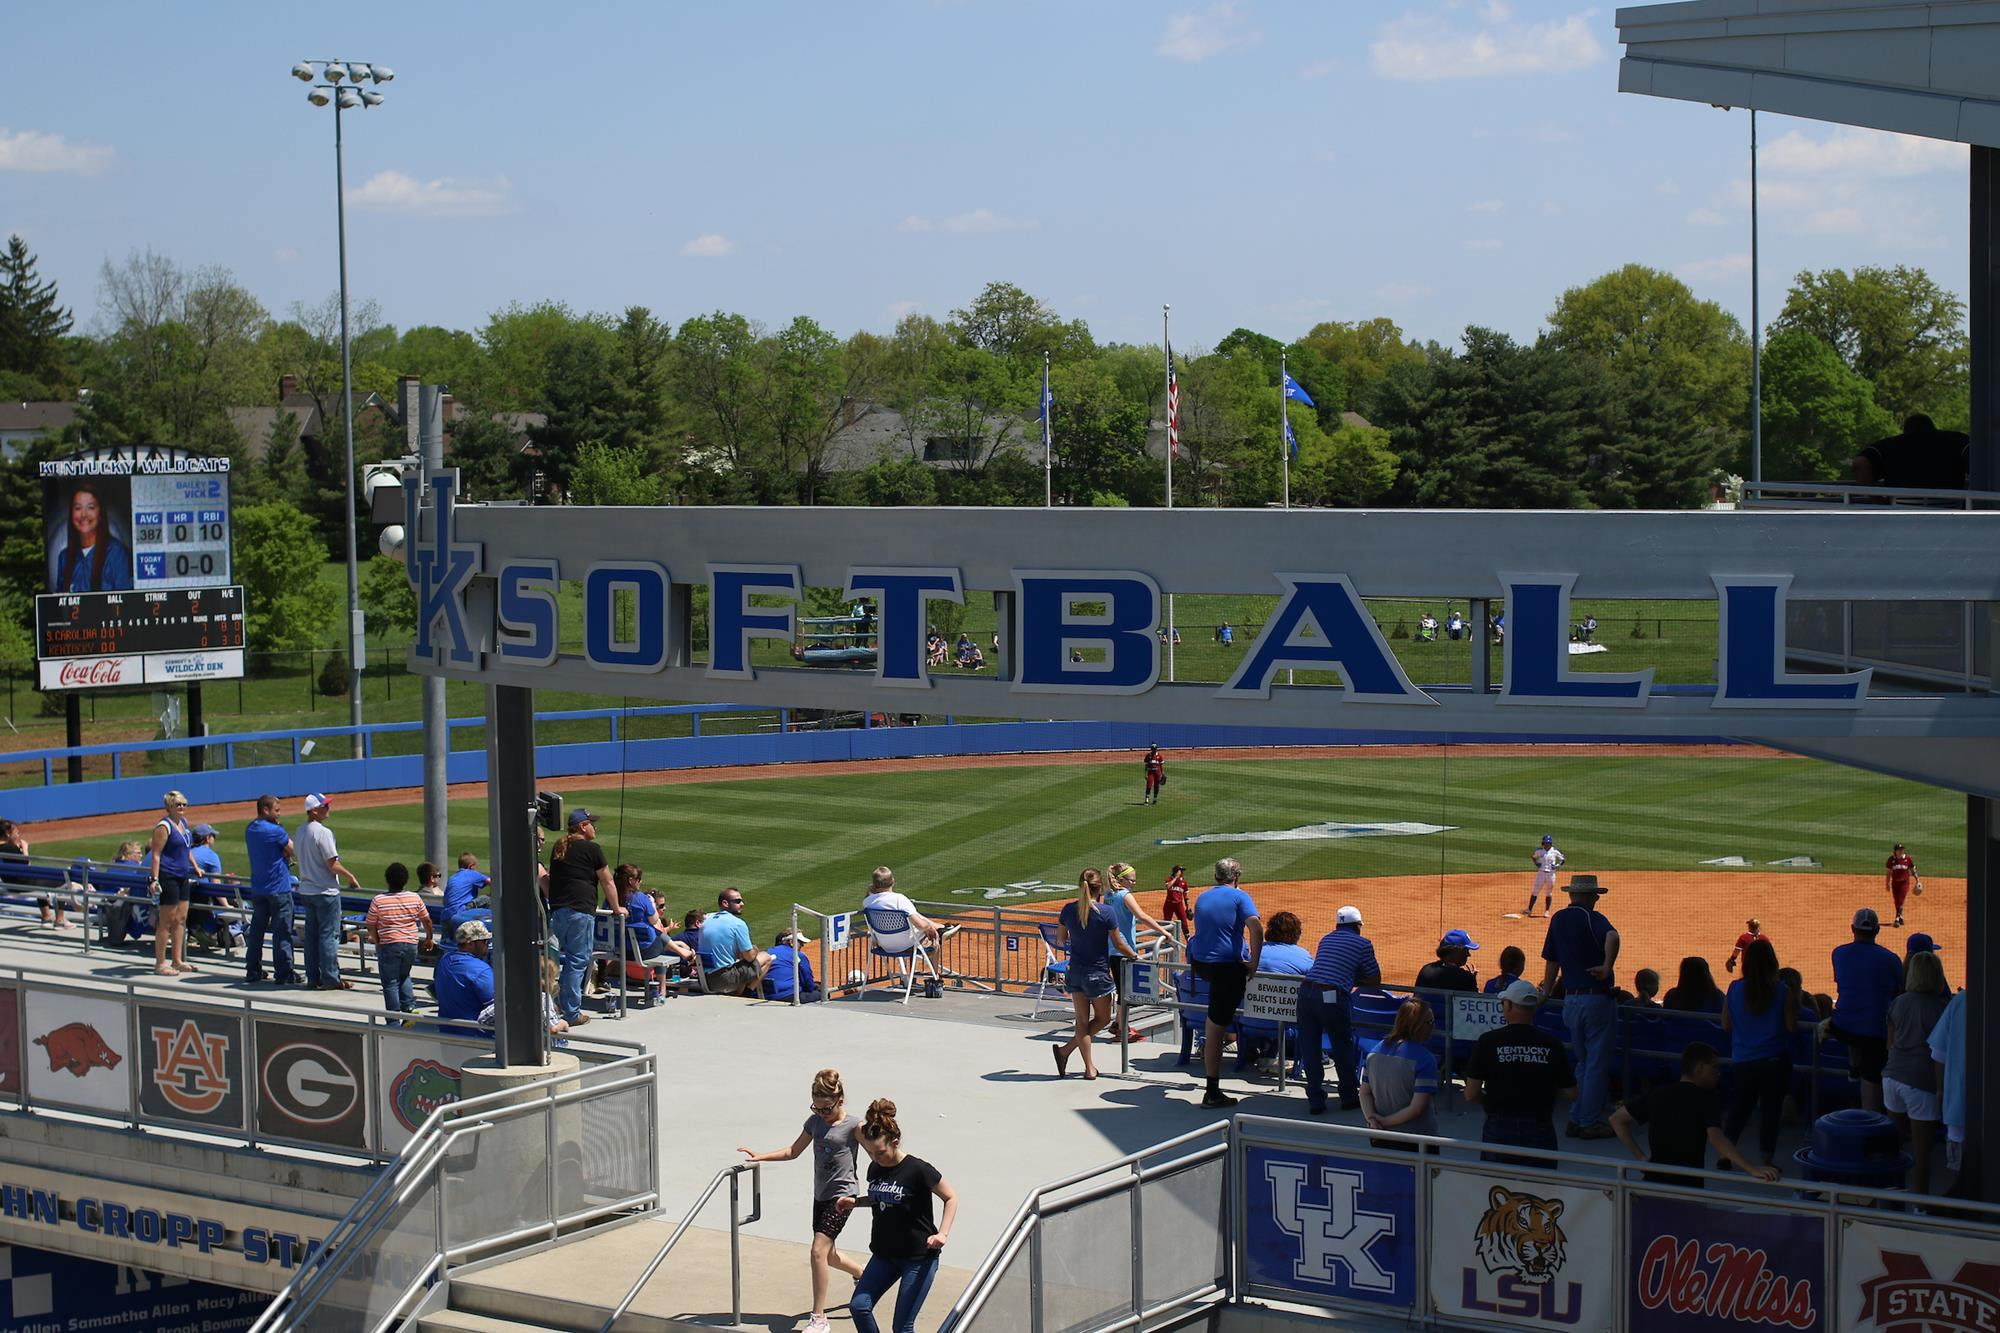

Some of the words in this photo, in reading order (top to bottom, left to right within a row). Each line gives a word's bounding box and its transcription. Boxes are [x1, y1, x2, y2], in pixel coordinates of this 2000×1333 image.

[39, 460, 135, 476] KENTUCKY
[142, 457, 230, 474] WILDCATS
[185, 490, 206, 498] VICK
[208, 481, 220, 498] 2
[140, 514, 158, 523] AVG
[173, 513, 187, 522] HR
[203, 511, 220, 521] RBI
[175, 524, 187, 541] 0
[200, 523, 223, 540] 10
[58, 597, 66, 606] AT
[68, 596, 80, 606] BAT
[107, 595, 123, 604] BALL
[144, 593, 167, 602] STRIKE
[188, 591, 202, 600] OUT
[500, 558, 1873, 712] SOFTBALL
[60, 659, 122, 685] Coca-Cola
[165, 663, 204, 673] WILDCAT
[207, 662, 223, 671] DEN
[834, 914, 845, 942] F
[1007, 938, 1017, 949] 3
[1132, 964, 1151, 993] E
[1258, 984, 1288, 994] BEWARE
[1247, 993, 1277, 1004] OBJECTS
[1279, 996, 1297, 1005] LEAV
[1459, 999, 1504, 1013] SECTIO
[1253, 1005, 1266, 1014] THE
[1268, 1006, 1296, 1017] PLAYFIE
[1496, 1046, 1551, 1056] KENTUCKY
[1499, 1054, 1549, 1064] SOFTBALL
[262, 1042, 358, 1124] G
[75, 1197, 226, 1255] CROPP
[1264, 1159, 1396, 1294] UK
[1638, 1234, 1709, 1314] Ole
[1706, 1242, 1817, 1330] Miss
[1461, 1266, 1583, 1326] LSU
[68, 1309, 149, 1331] Samantha
[197, 1296, 235, 1312] Macy
[1888, 1288, 1998, 1332] STATE
